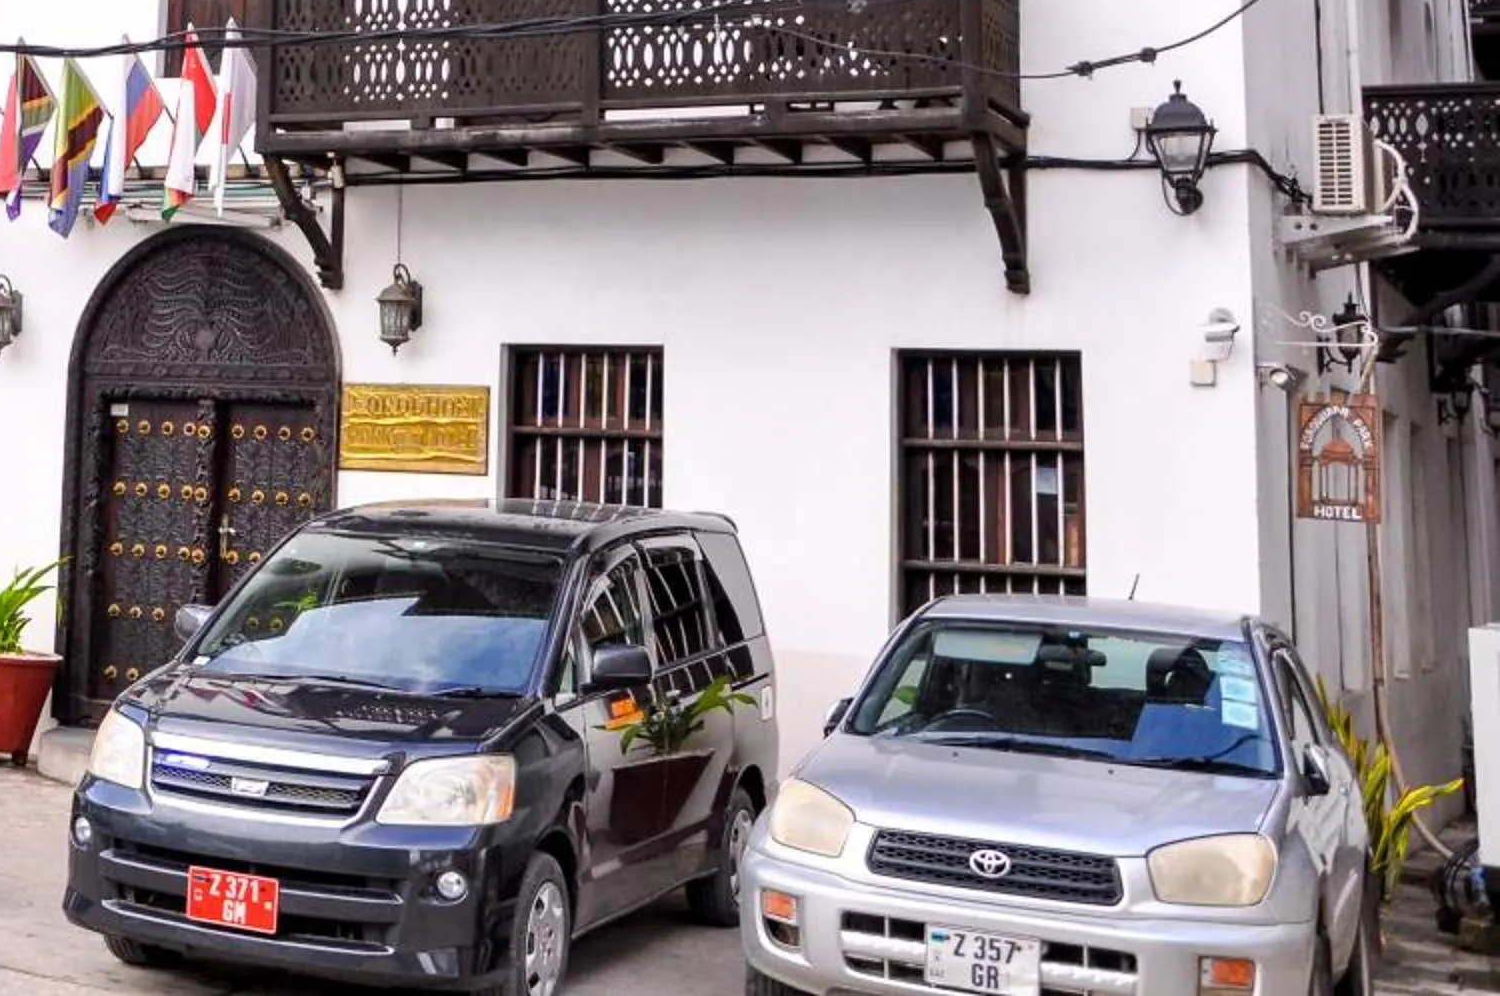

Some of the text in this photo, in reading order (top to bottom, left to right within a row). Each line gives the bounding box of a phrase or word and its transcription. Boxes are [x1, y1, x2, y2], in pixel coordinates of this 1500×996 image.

[1313, 504, 1363, 520] HOTEL
[208, 873, 259, 903] Z 371
[953, 933, 1016, 964] Z 357
[971, 963, 999, 989] GR
